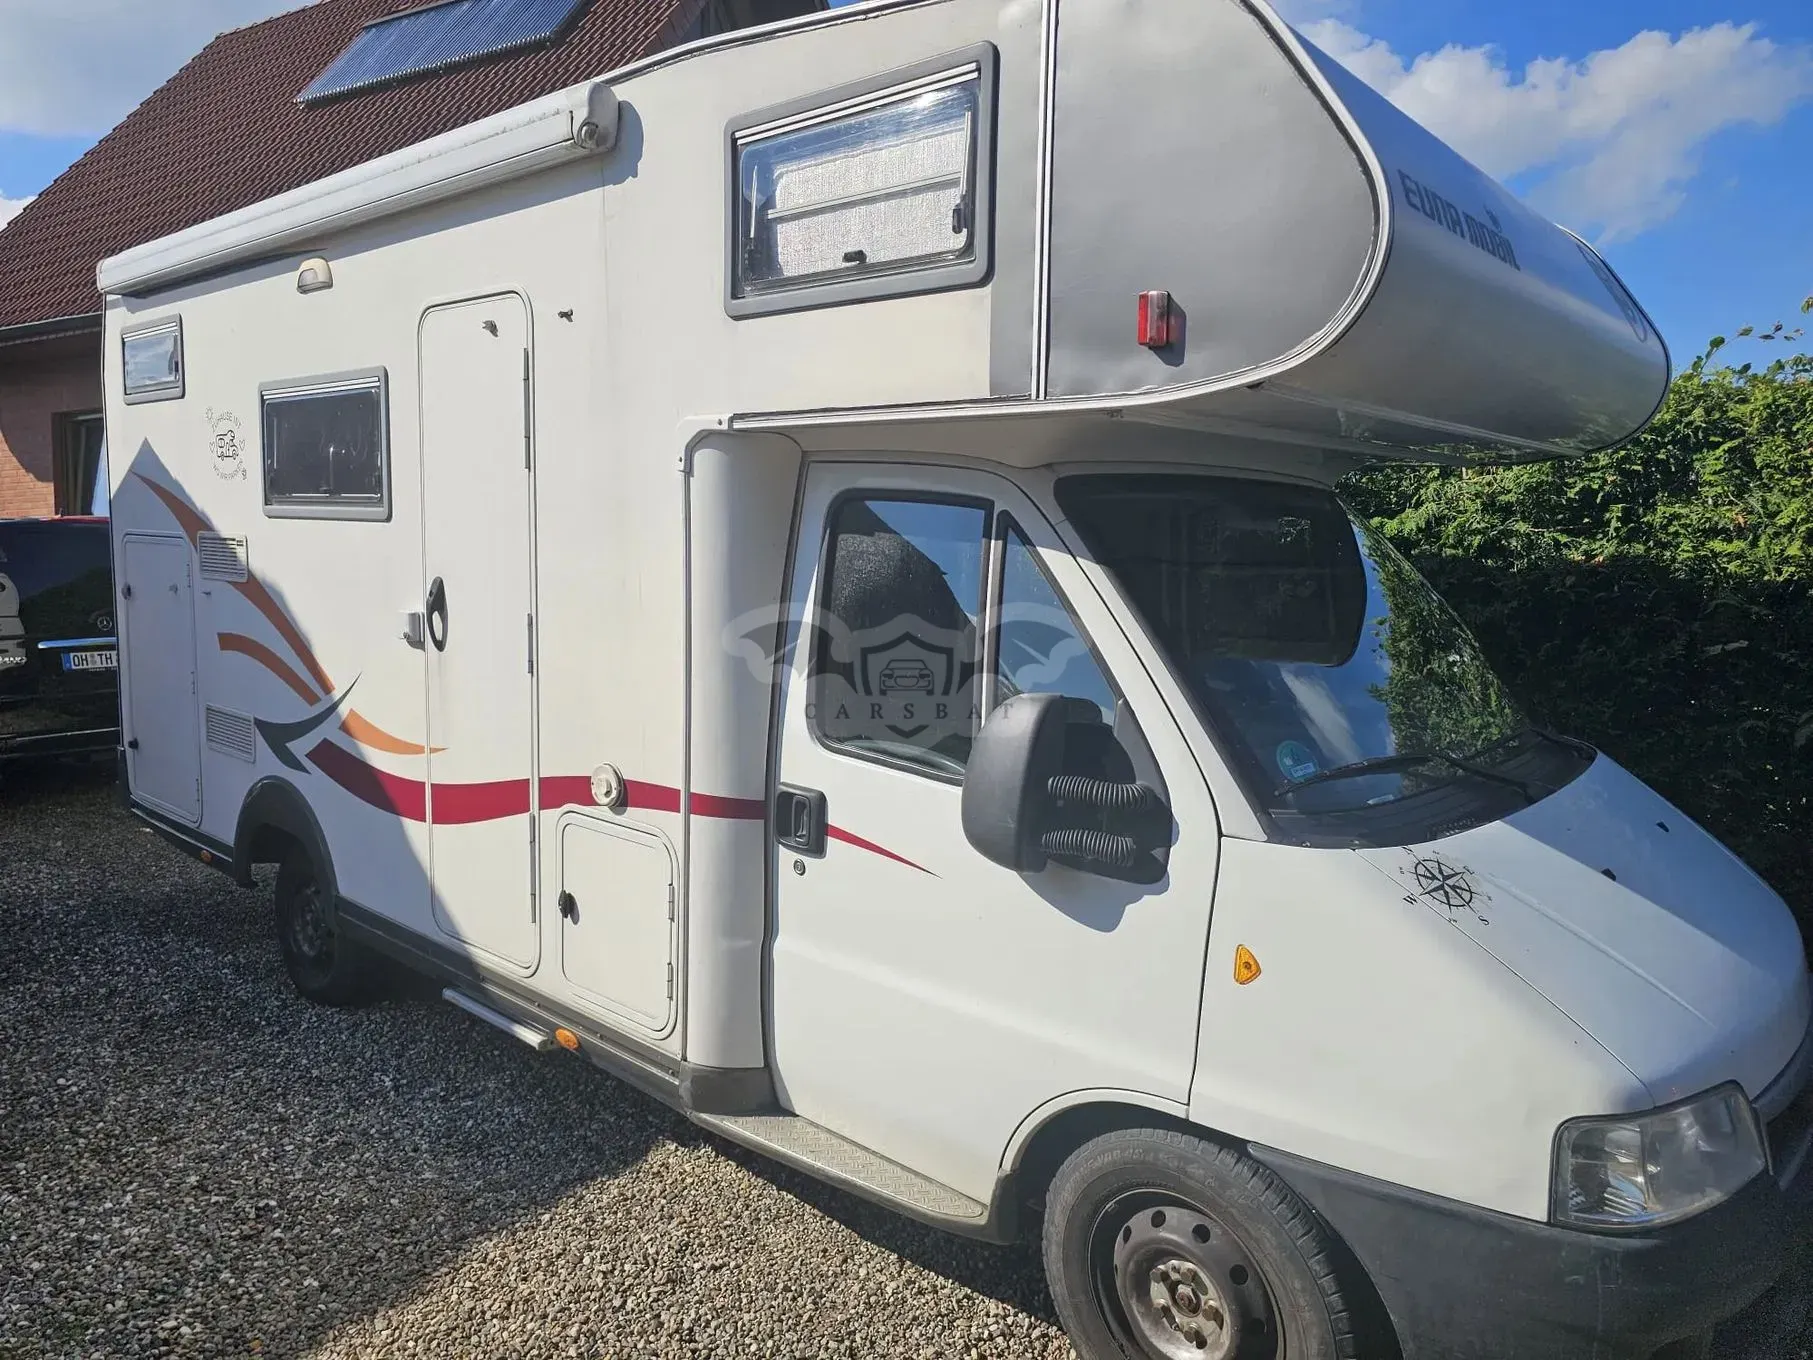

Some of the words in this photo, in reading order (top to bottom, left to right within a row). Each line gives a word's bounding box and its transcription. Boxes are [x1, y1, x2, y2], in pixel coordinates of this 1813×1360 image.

[72, 654, 89, 667] OH
[98, 653, 113, 666] TH
[1403, 893, 1418, 905] W
[1477, 915, 1490, 926] S
